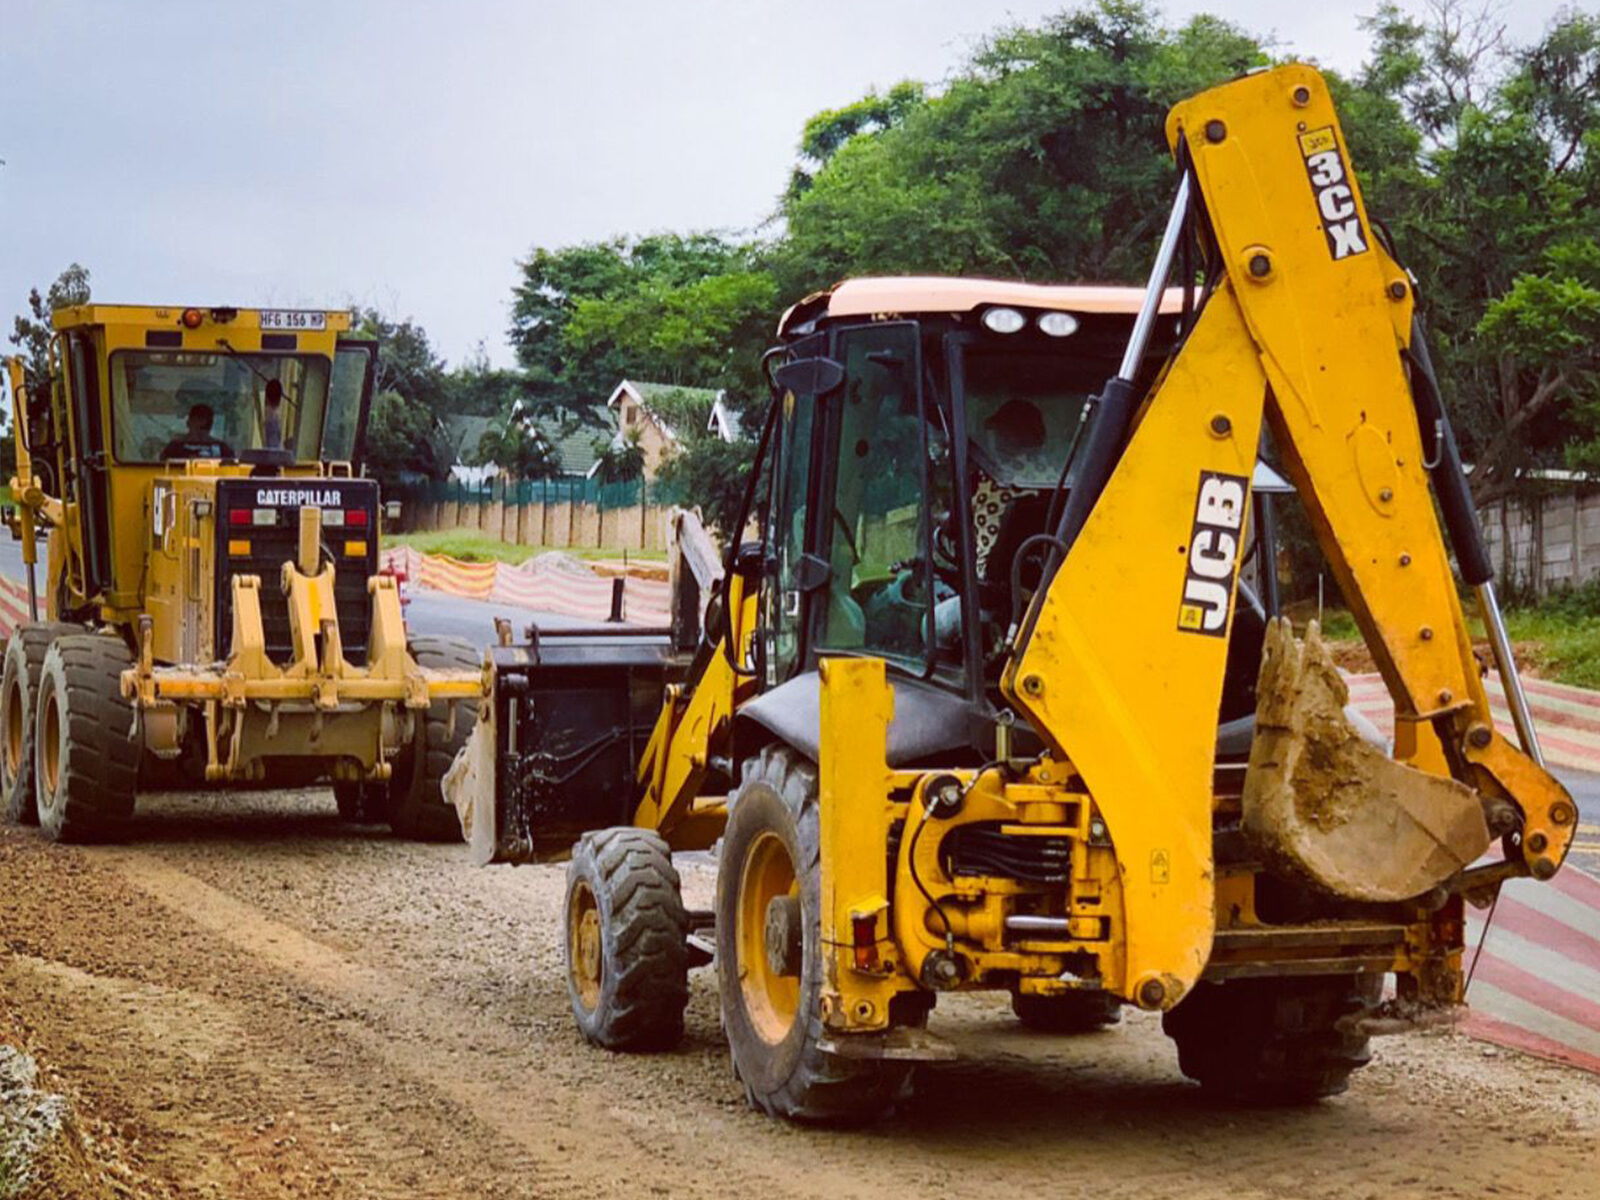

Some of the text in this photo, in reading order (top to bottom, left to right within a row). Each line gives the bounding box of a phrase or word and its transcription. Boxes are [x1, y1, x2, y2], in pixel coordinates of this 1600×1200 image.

[1308, 151, 1367, 259] 3CX
[261, 312, 281, 326] HFG
[287, 313, 306, 326] 156
[256, 489, 341, 506] CATERPILLAR
[1185, 478, 1243, 630] JCB
